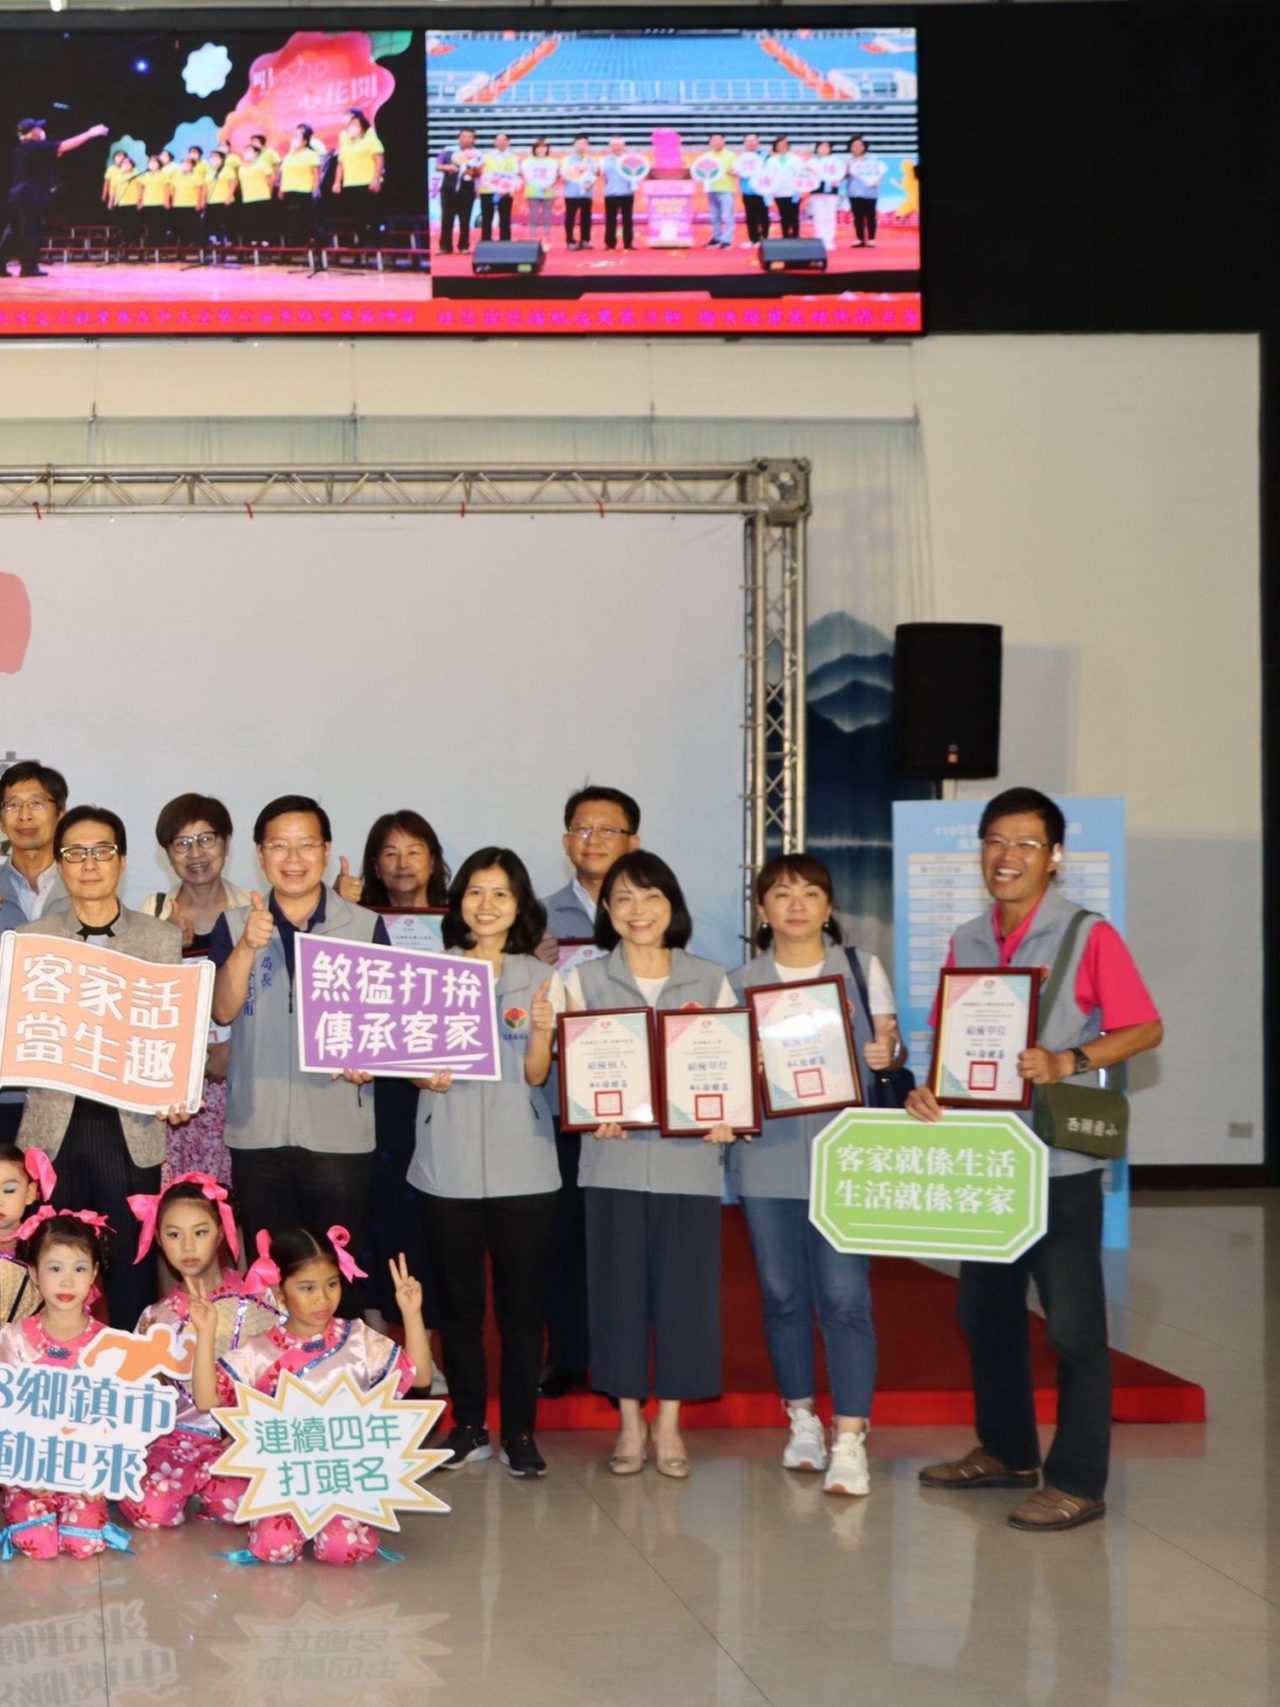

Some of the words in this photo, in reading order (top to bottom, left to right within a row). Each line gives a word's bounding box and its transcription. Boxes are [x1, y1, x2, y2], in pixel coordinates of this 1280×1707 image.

[22, 953, 182, 1030] 客家話
[16, 1011, 177, 1088] 當生趣
[315, 1011, 483, 1060] 傳承客家
[835, 1143, 1017, 1179] 客家就係生活
[834, 1178, 1016, 1216] 生活就係客家
[255, 1414, 402, 1457] 連續四年
[278, 1455, 390, 1497] 打頭名
